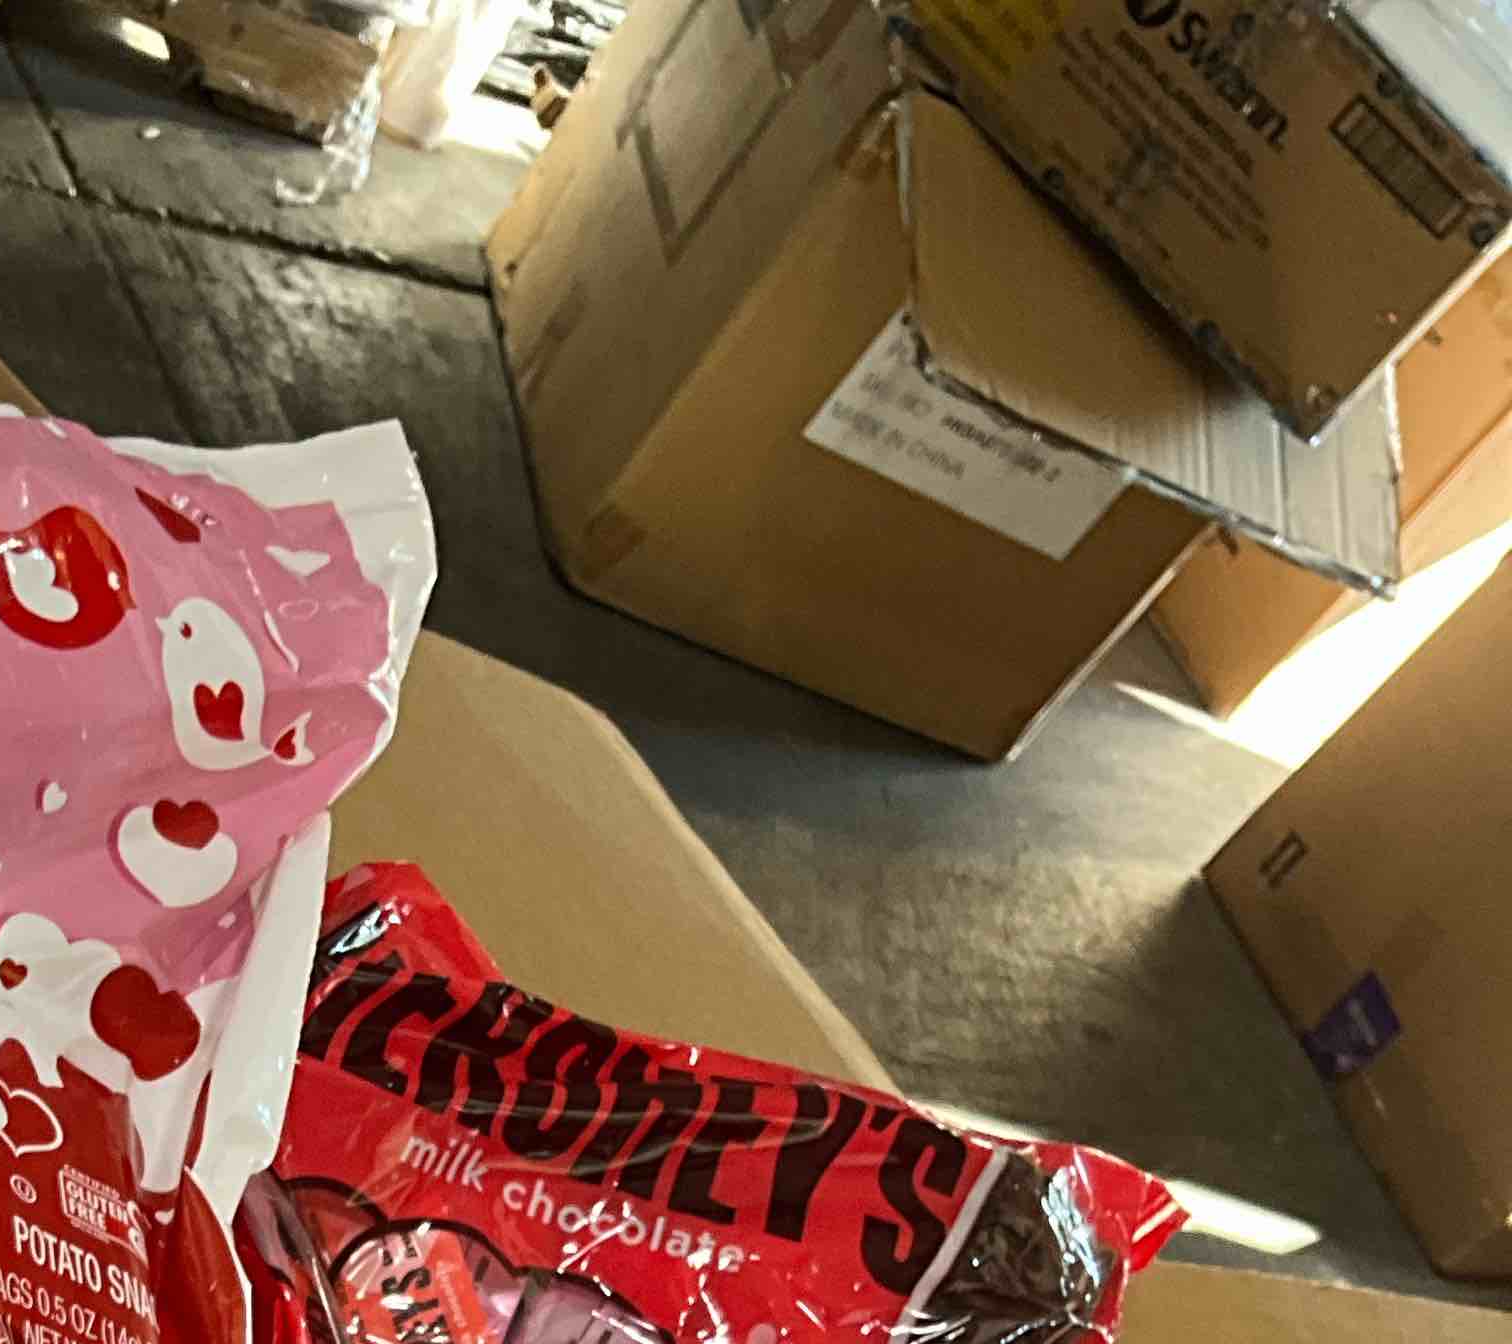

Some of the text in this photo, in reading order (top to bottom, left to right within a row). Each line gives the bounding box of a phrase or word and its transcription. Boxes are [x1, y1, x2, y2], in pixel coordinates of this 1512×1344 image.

[65, 1180, 130, 1227] GLUTEN
[68, 1197, 107, 1232] FREE
[399, 1128, 491, 1193] milk
[502, 1176, 746, 1274] chocolate
[13, 1214, 103, 1294] POTATO
[37, 1286, 68, 1327] 0.5
[70, 1303, 99, 1341] OZ
